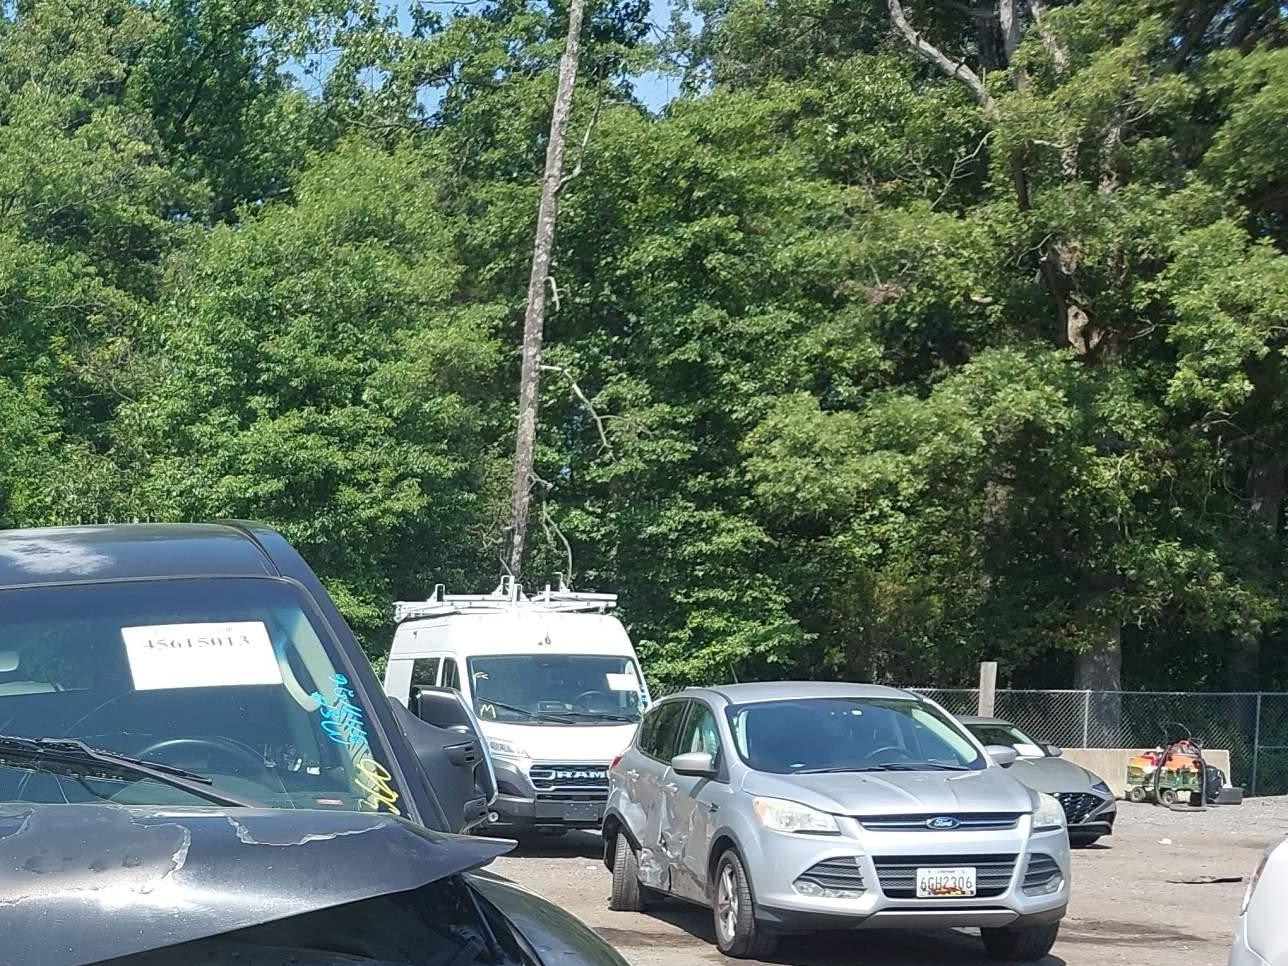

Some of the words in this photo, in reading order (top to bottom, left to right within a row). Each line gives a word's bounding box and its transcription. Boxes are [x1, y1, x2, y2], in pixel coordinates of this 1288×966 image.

[143, 634, 251, 650] 45615013
[480, 704, 496, 718] M
[557, 770, 606, 778] RAM
[934, 817, 953, 827] Ford
